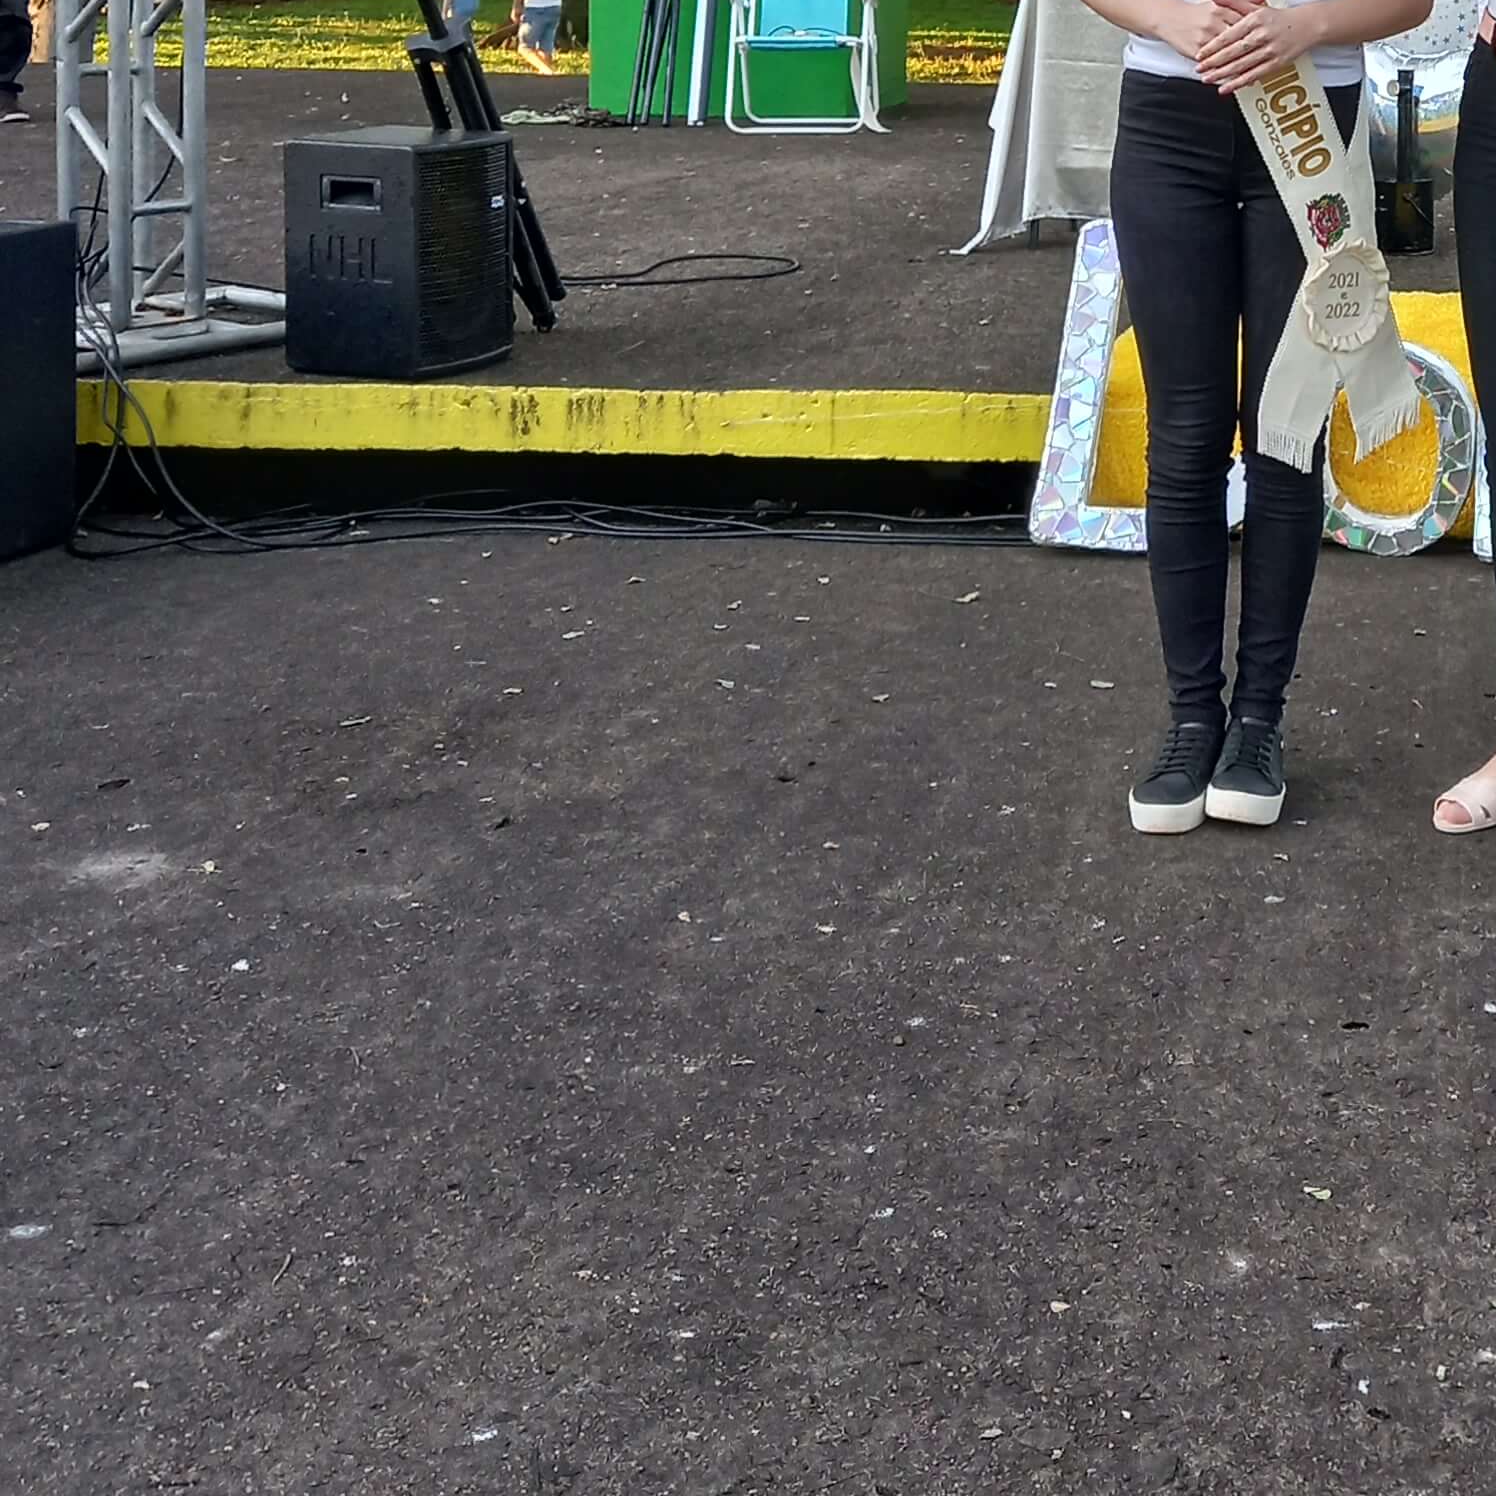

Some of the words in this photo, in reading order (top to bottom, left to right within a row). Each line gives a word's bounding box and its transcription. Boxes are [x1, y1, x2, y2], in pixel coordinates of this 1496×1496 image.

[1261, 61, 1332, 178] ICÍPIO
[1255, 97, 1296, 181] Gonzales
[1328, 271, 1360, 290] 2021
[1340, 291, 1348, 300] e
[1325, 301, 1361, 320] 2022
